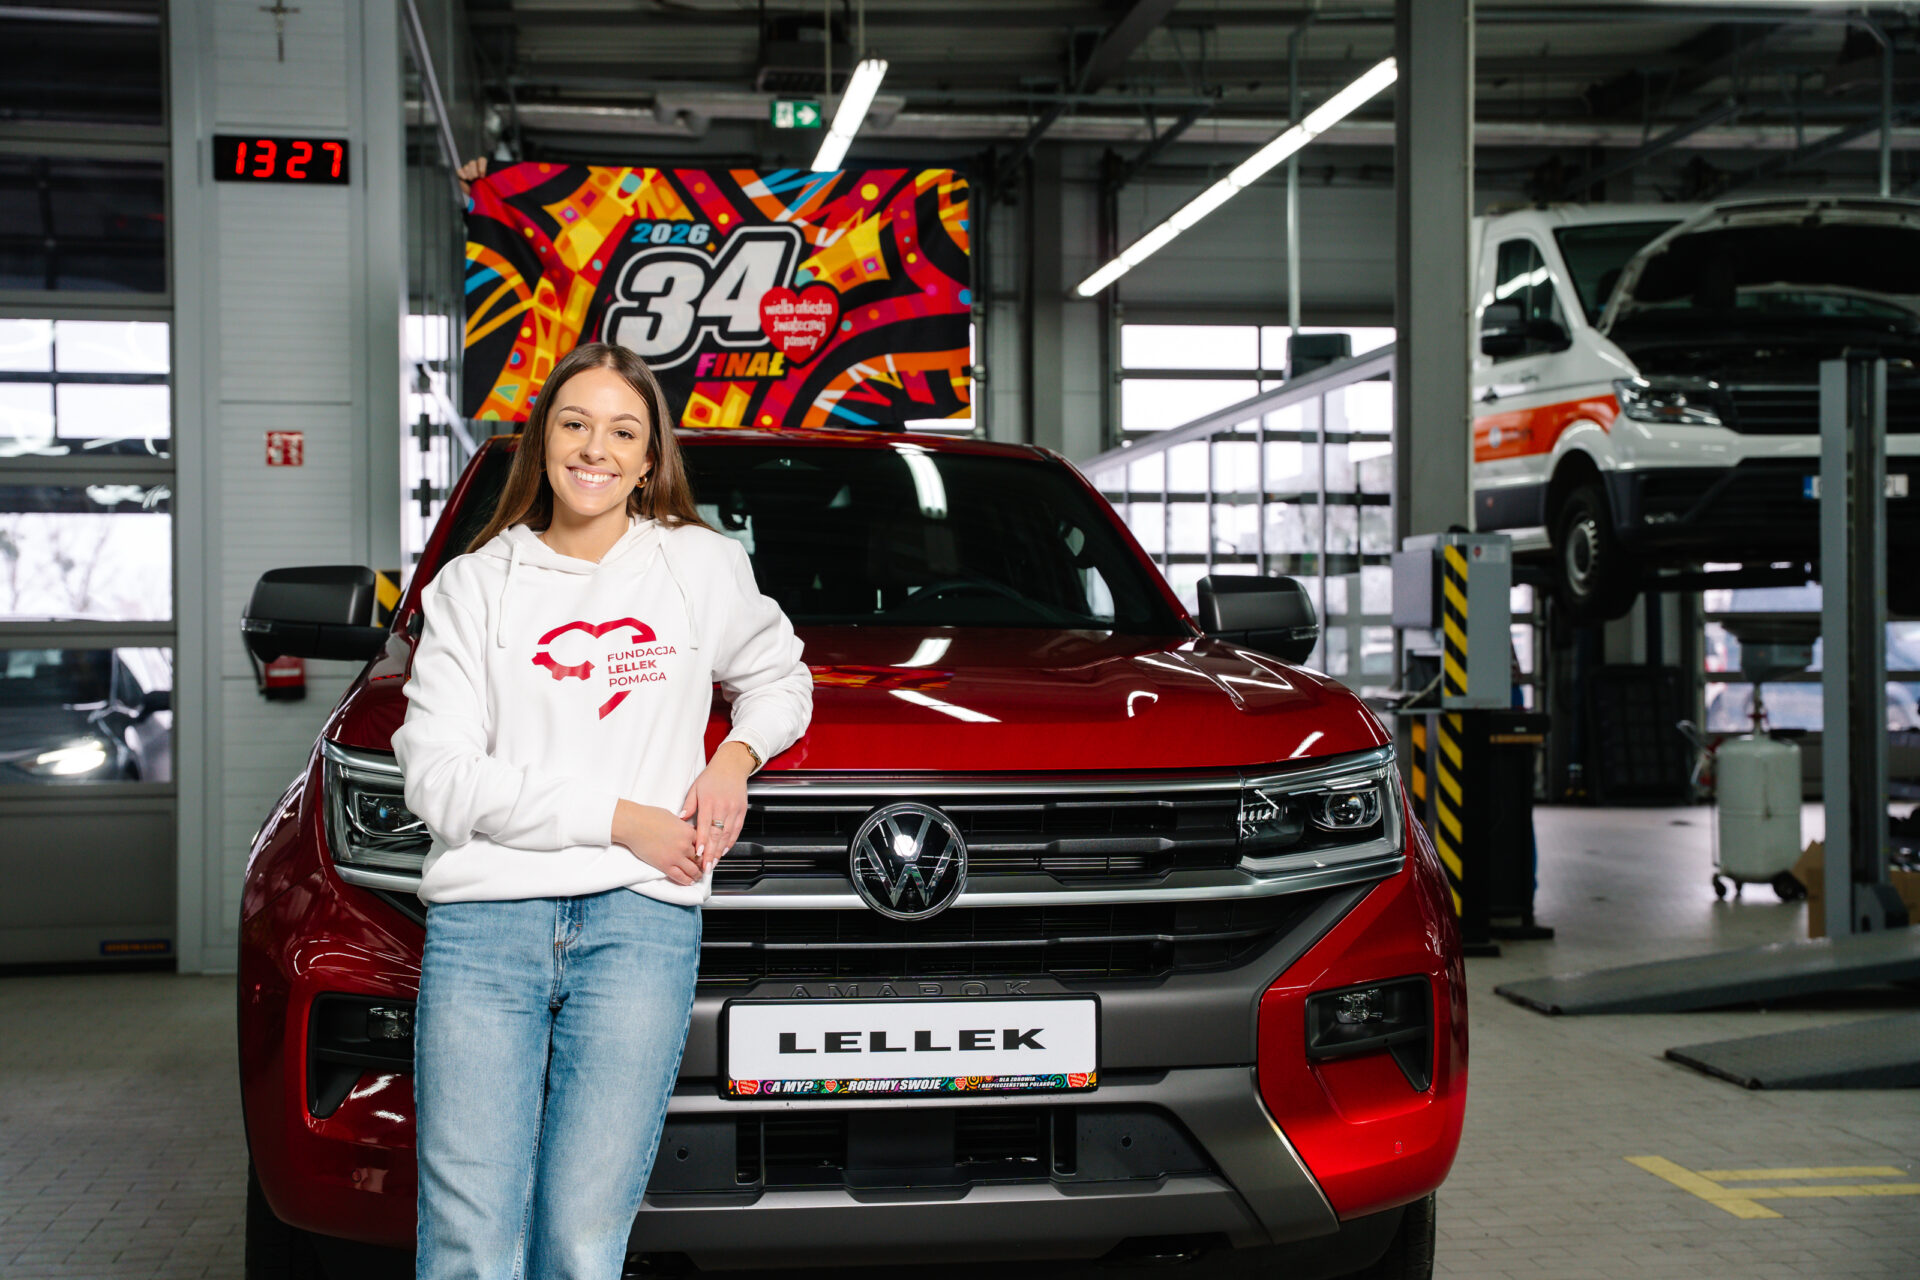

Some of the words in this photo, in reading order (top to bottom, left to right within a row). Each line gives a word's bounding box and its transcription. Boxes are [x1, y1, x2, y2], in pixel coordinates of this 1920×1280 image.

[630, 223, 710, 244] 2026
[609, 232, 796, 362] 34
[764, 298, 795, 316] wielka
[783, 335, 818, 351] pomocy
[694, 352, 786, 377] FINAŁ
[607, 646, 676, 662] FUNDACJA
[608, 659, 657, 675] LELLEK
[609, 672, 666, 687] POMAGA
[790, 981, 1030, 997] AMAROK
[779, 1028, 1046, 1054] LELLEK
[770, 1080, 781, 1093] A
[783, 1080, 815, 1092] MY?
[848, 1079, 899, 1092] ROBIMY
[900, 1078, 942, 1091] SWOJE
